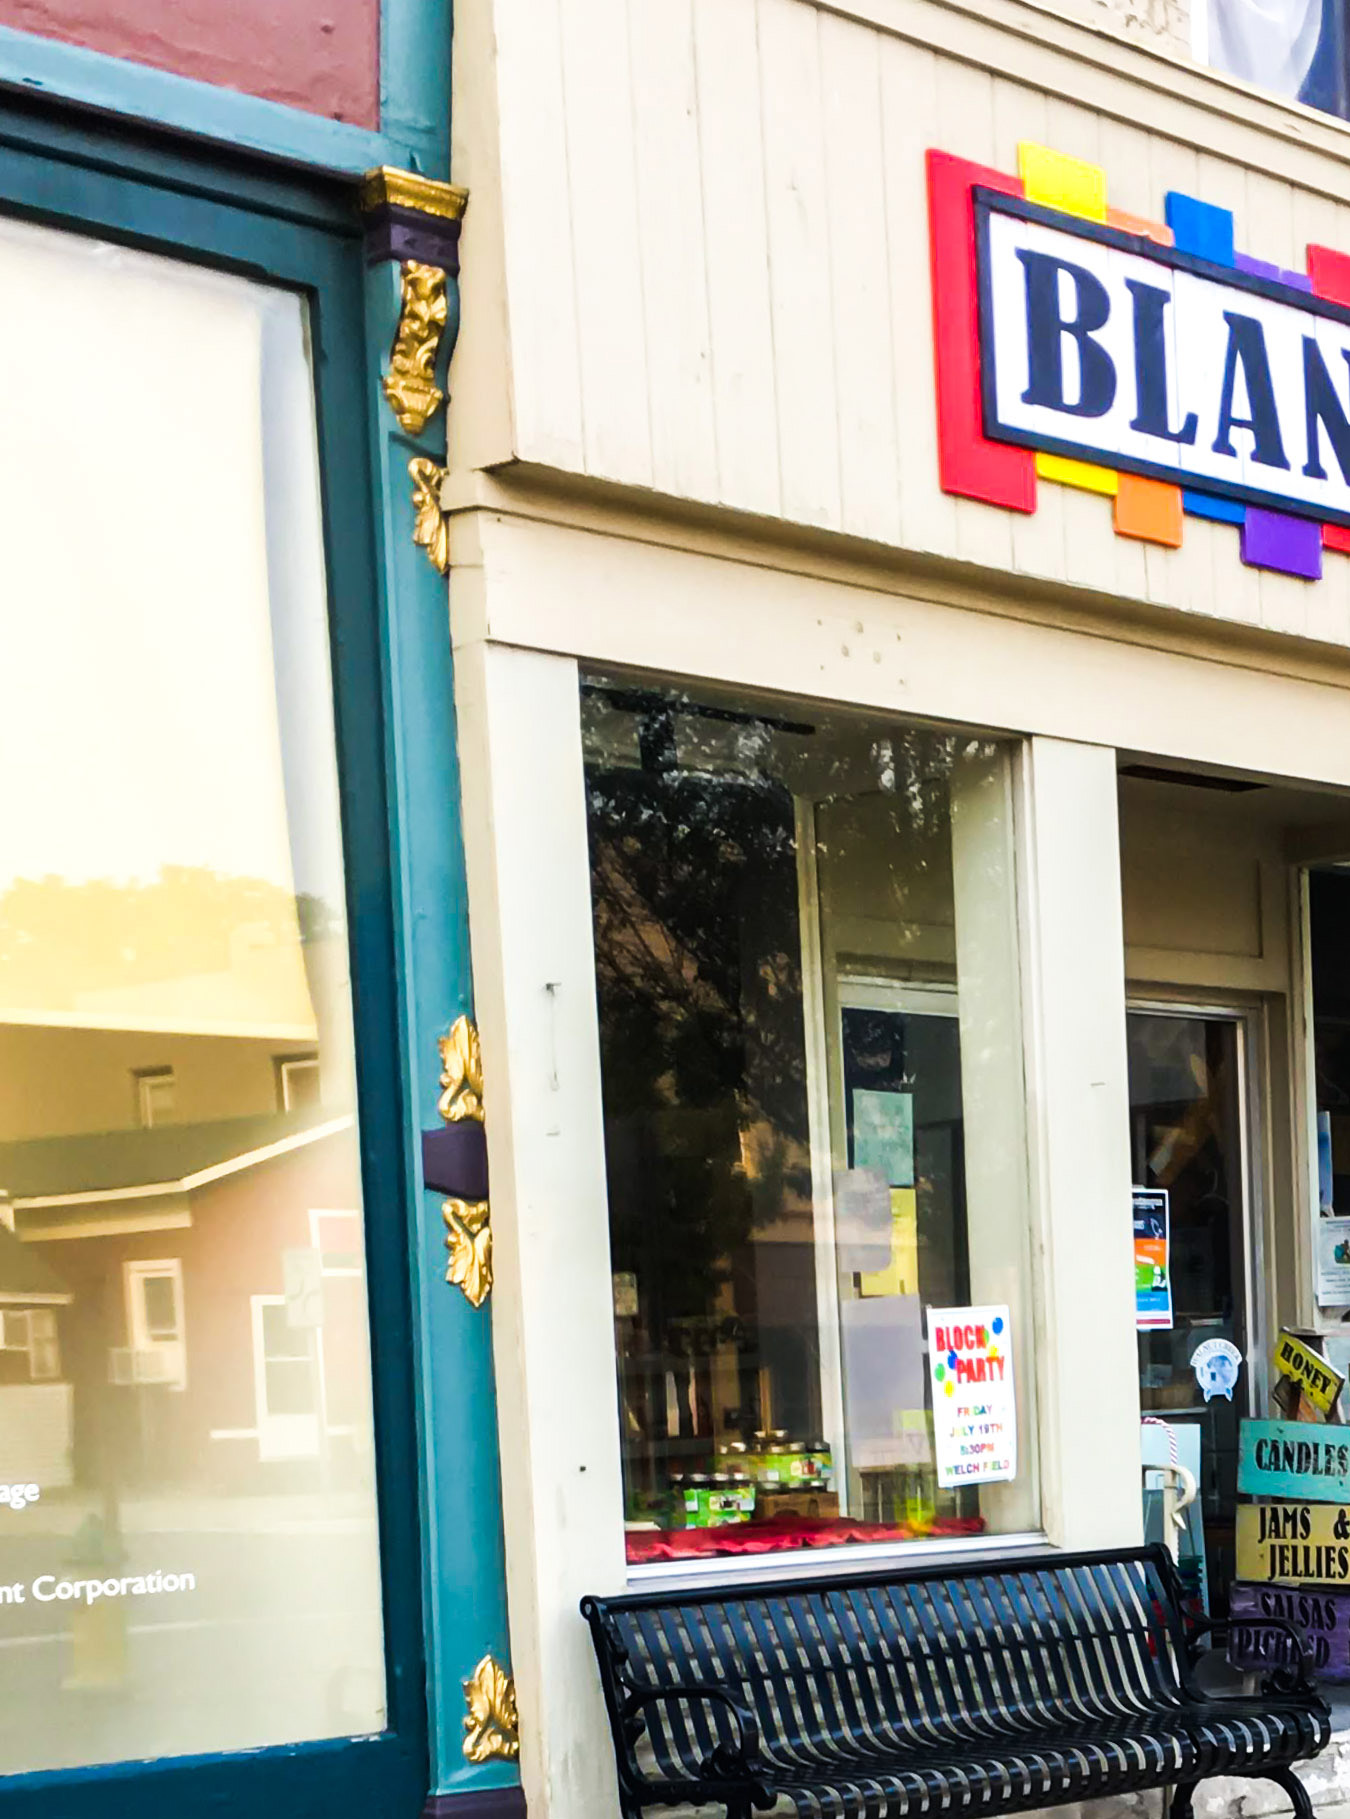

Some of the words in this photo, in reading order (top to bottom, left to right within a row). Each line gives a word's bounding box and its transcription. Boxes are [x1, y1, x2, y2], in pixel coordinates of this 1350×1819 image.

[935, 1325, 987, 1352] BLOCK
[956, 1356, 1005, 1384] PARTY
[1280, 1341, 1331, 1395] HONEY
[957, 1404, 993, 1417] FRIDAY
[949, 1424, 975, 1438] JULY
[944, 1461, 980, 1477] WELCH
[983, 1459, 1010, 1473] FIELD
[1255, 1437, 1349, 1477] CANDLES
[0, 1483, 41, 1510] age
[1258, 1506, 1312, 1544] JAMS
[1333, 1508, 1350, 1541] &
[1267, 1544, 1350, 1581] JELLIES
[0, 1582, 26, 1604] nt
[31, 1569, 196, 1606] Corporation
[1260, 1591, 1337, 1632] SALSAS
